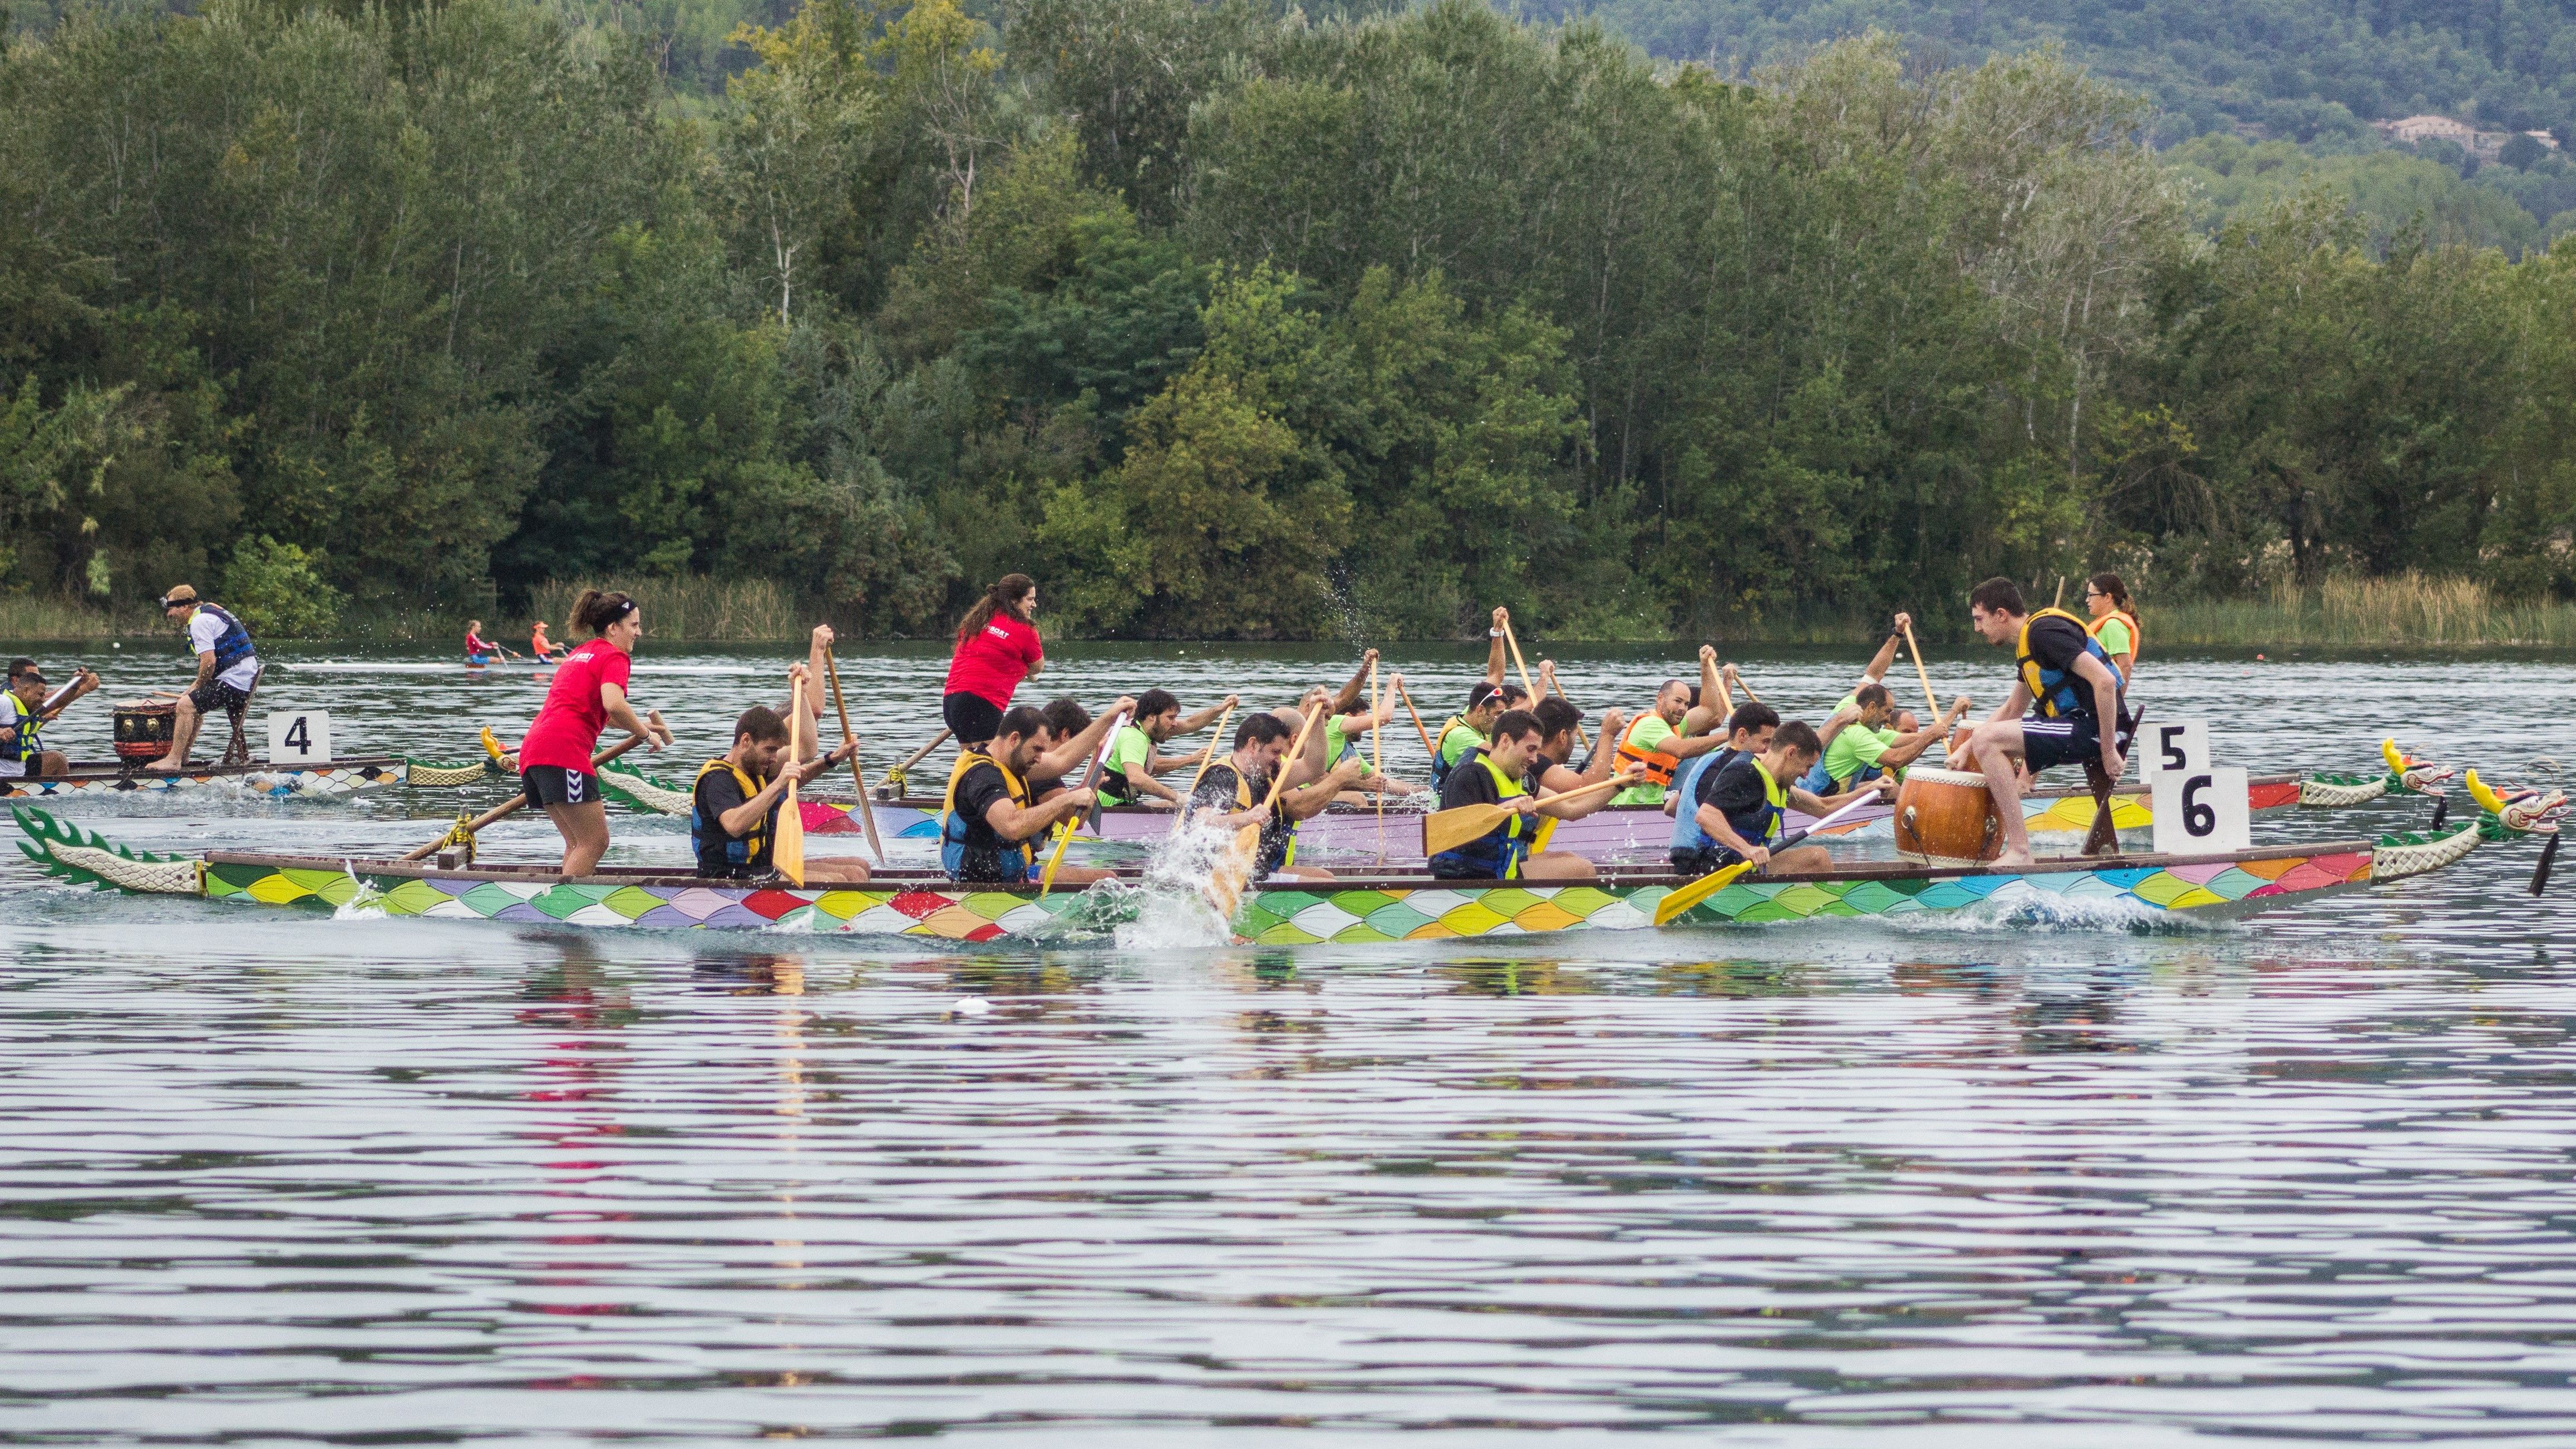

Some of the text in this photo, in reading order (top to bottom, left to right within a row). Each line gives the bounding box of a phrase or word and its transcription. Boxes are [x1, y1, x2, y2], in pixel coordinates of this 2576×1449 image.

[284, 716, 312, 755] 4
[2160, 726, 2186, 771] 5
[2181, 775, 2215, 837] 6
